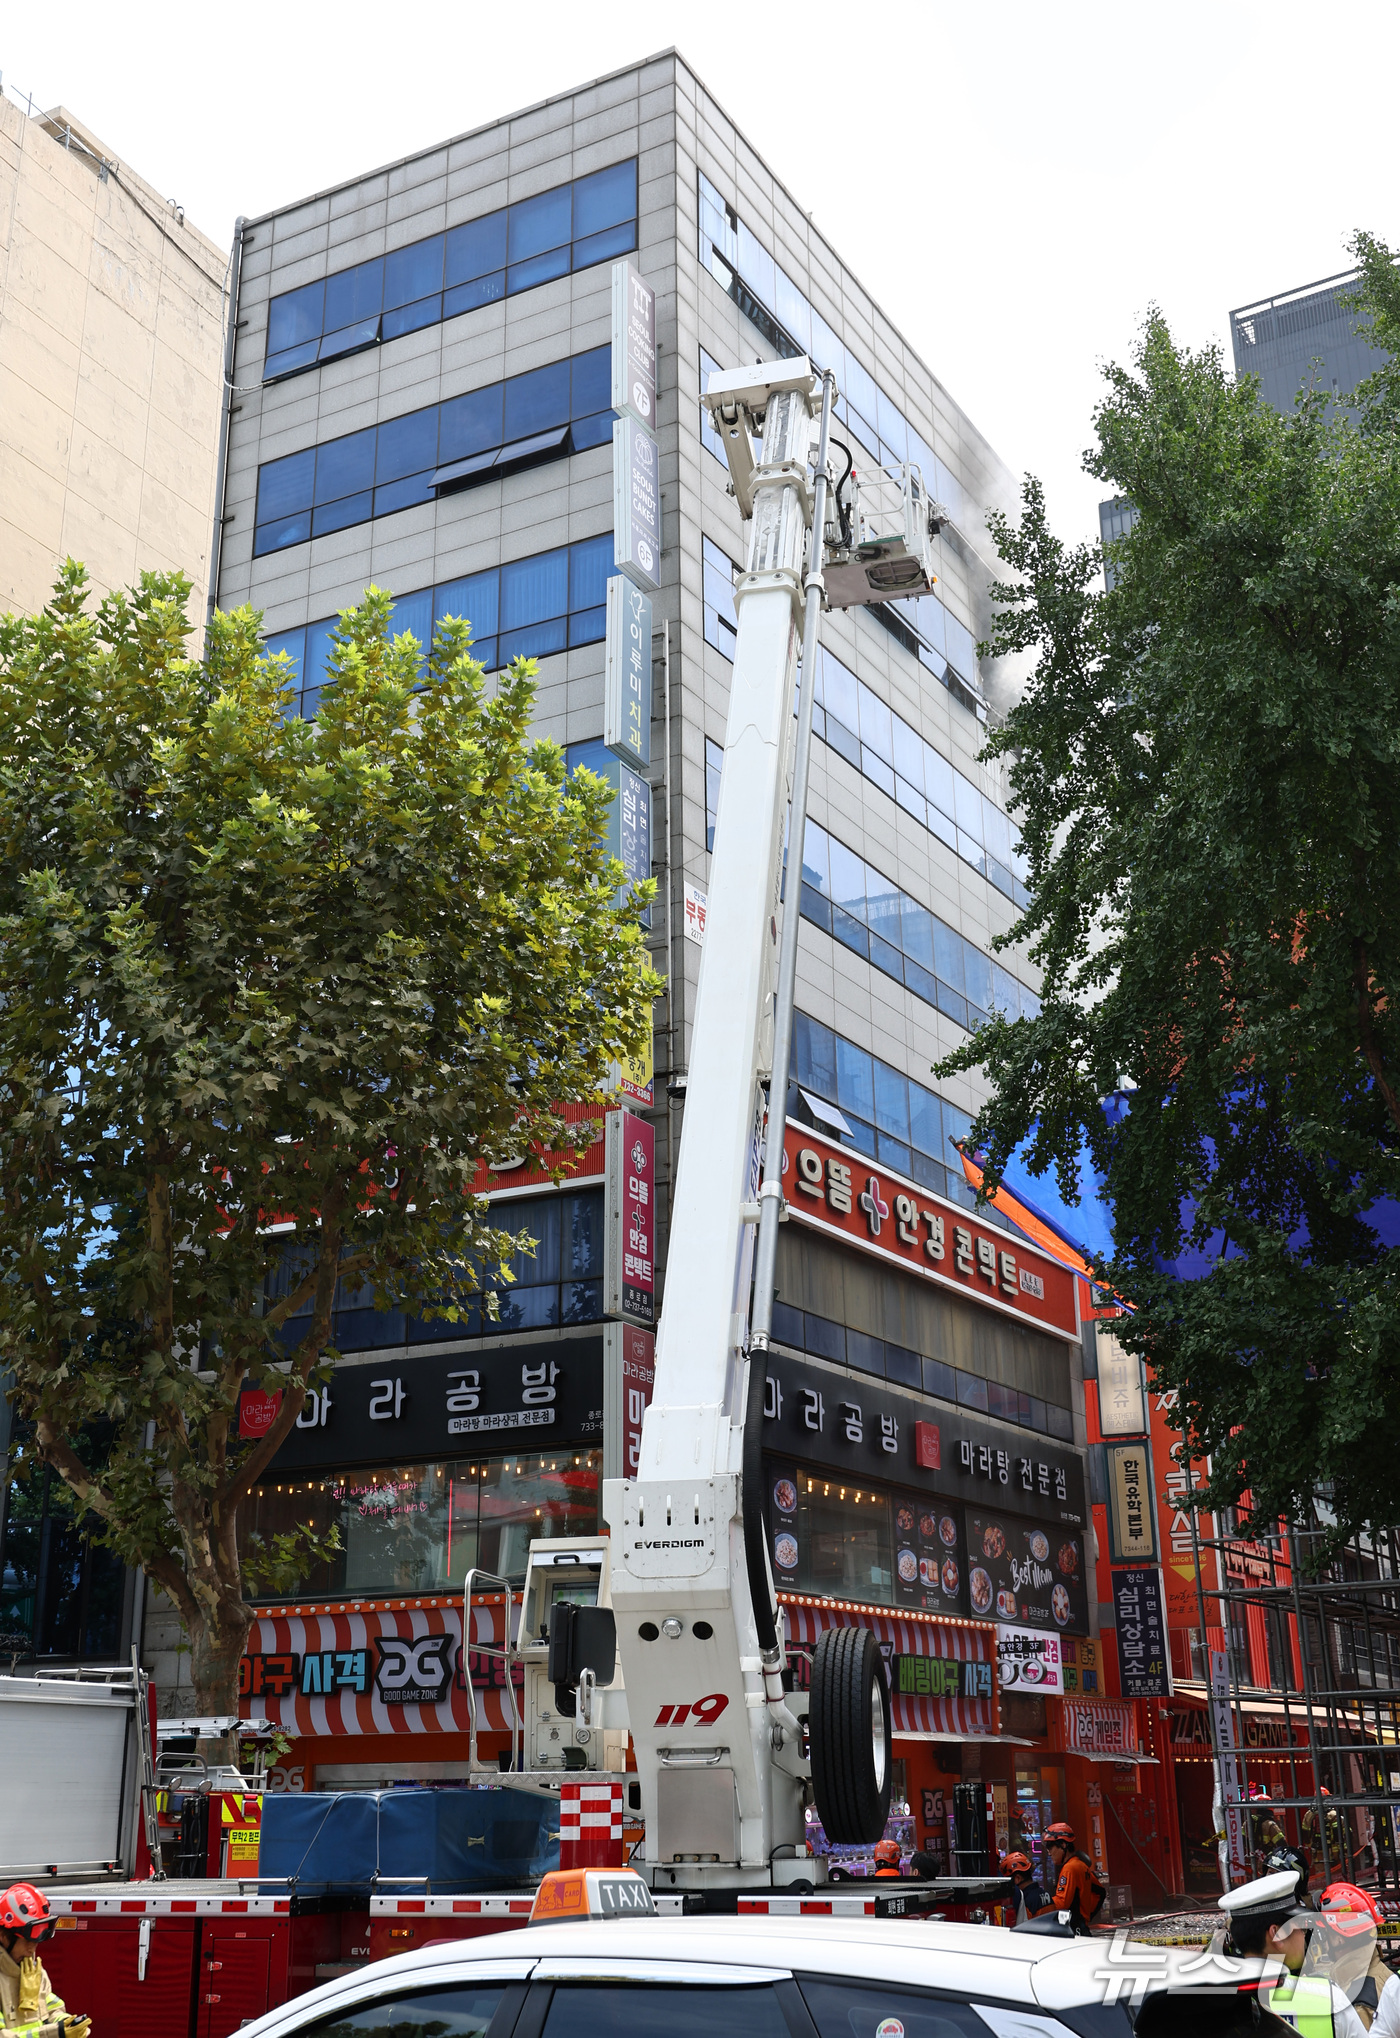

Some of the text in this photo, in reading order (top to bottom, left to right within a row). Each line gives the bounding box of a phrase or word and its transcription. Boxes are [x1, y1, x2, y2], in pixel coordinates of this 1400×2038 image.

[628, 325, 655, 361] COOKING
[632, 315, 651, 343] SEOUL
[633, 345, 650, 369] CLUB
[635, 385, 648, 410] 7F
[632, 467, 655, 497] SEOUL
[632, 482, 657, 513] BUNDT
[632, 497, 655, 526] CAKES
[640, 547, 652, 565] 6F
[629, 622, 643, 755] 이루미치과
[628, 776, 641, 794] 정신
[628, 1175, 649, 1205] 으뜸
[797, 1148, 853, 1214] 으뜸
[895, 1194, 946, 1260] 안경
[629, 1228, 648, 1256] 안경
[622, 1359, 655, 1384] 마라공방
[295, 1360, 561, 1429] 마라공방
[453, 1418, 481, 1432] 마라탕
[522, 1410, 550, 1424] 전문점
[588, 1410, 604, 1420] 종로
[764, 1376, 900, 1454] 마라공방
[1115, 1449, 1125, 1457] 5F
[960, 1440, 1010, 1485] 마라탕
[1020, 1458, 1067, 1501] 전문점
[1123, 1460, 1144, 1541] 한국유학본부
[634, 1539, 705, 1550] EVERDIGM
[1168, 1554, 1207, 1564] since196
[1010, 1555, 1033, 1593] Best
[1126, 1573, 1144, 1584] 정신
[1117, 1586, 1146, 1676] 심리상담소
[1145, 1586, 1161, 1656] 최면술치료
[302, 1652, 365, 1694] 사격
[899, 1656, 992, 1697] 배팅야구 사격
[1148, 1661, 1163, 1675] 4F
[384, 1690, 438, 1701] GOOD GAME ZONE
[653, 1693, 729, 1728] 119
[1095, 1720, 1122, 1745] 게임존
[248, 1831, 260, 1842] 펌프
[564, 1884, 649, 1908] CARD TAXI
